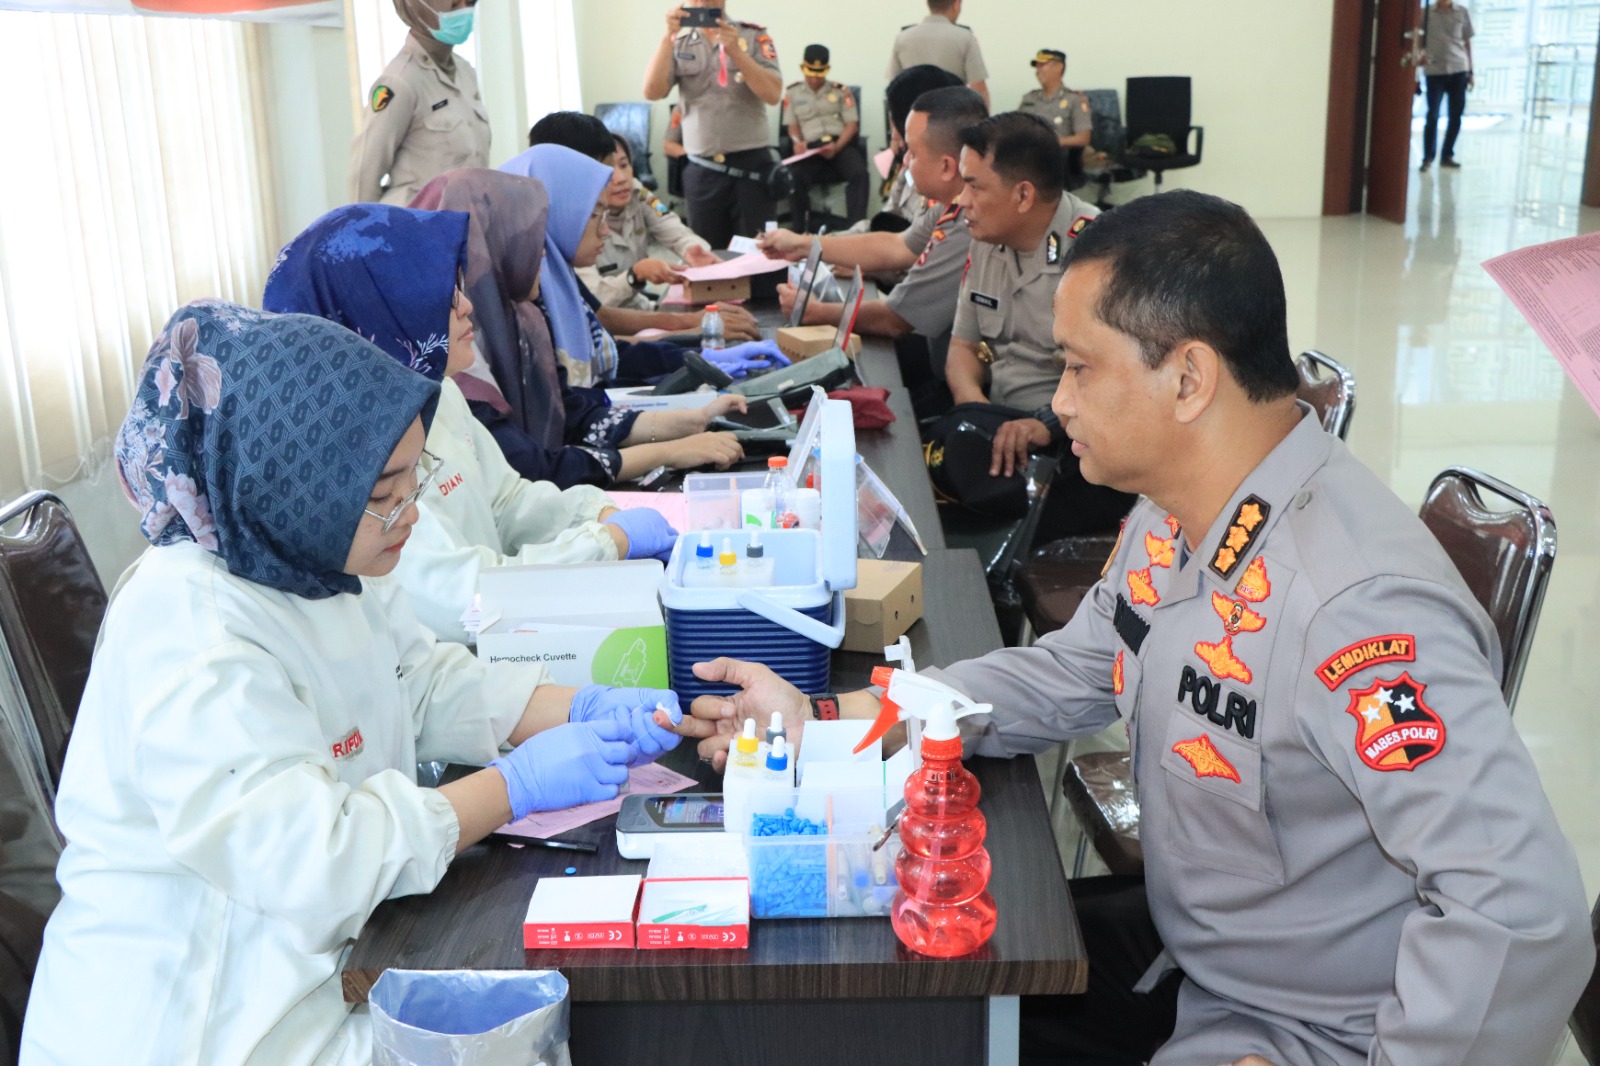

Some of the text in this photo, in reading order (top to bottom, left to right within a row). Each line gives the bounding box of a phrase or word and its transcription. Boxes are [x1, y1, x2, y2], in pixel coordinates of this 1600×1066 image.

[439, 472, 463, 496] DIAN
[543, 653, 577, 661] Cuvette
[1323, 639, 1409, 682] LEMDIKLAT
[1178, 665, 1256, 739] POLRI
[1364, 727, 1438, 759] MABES POLRI
